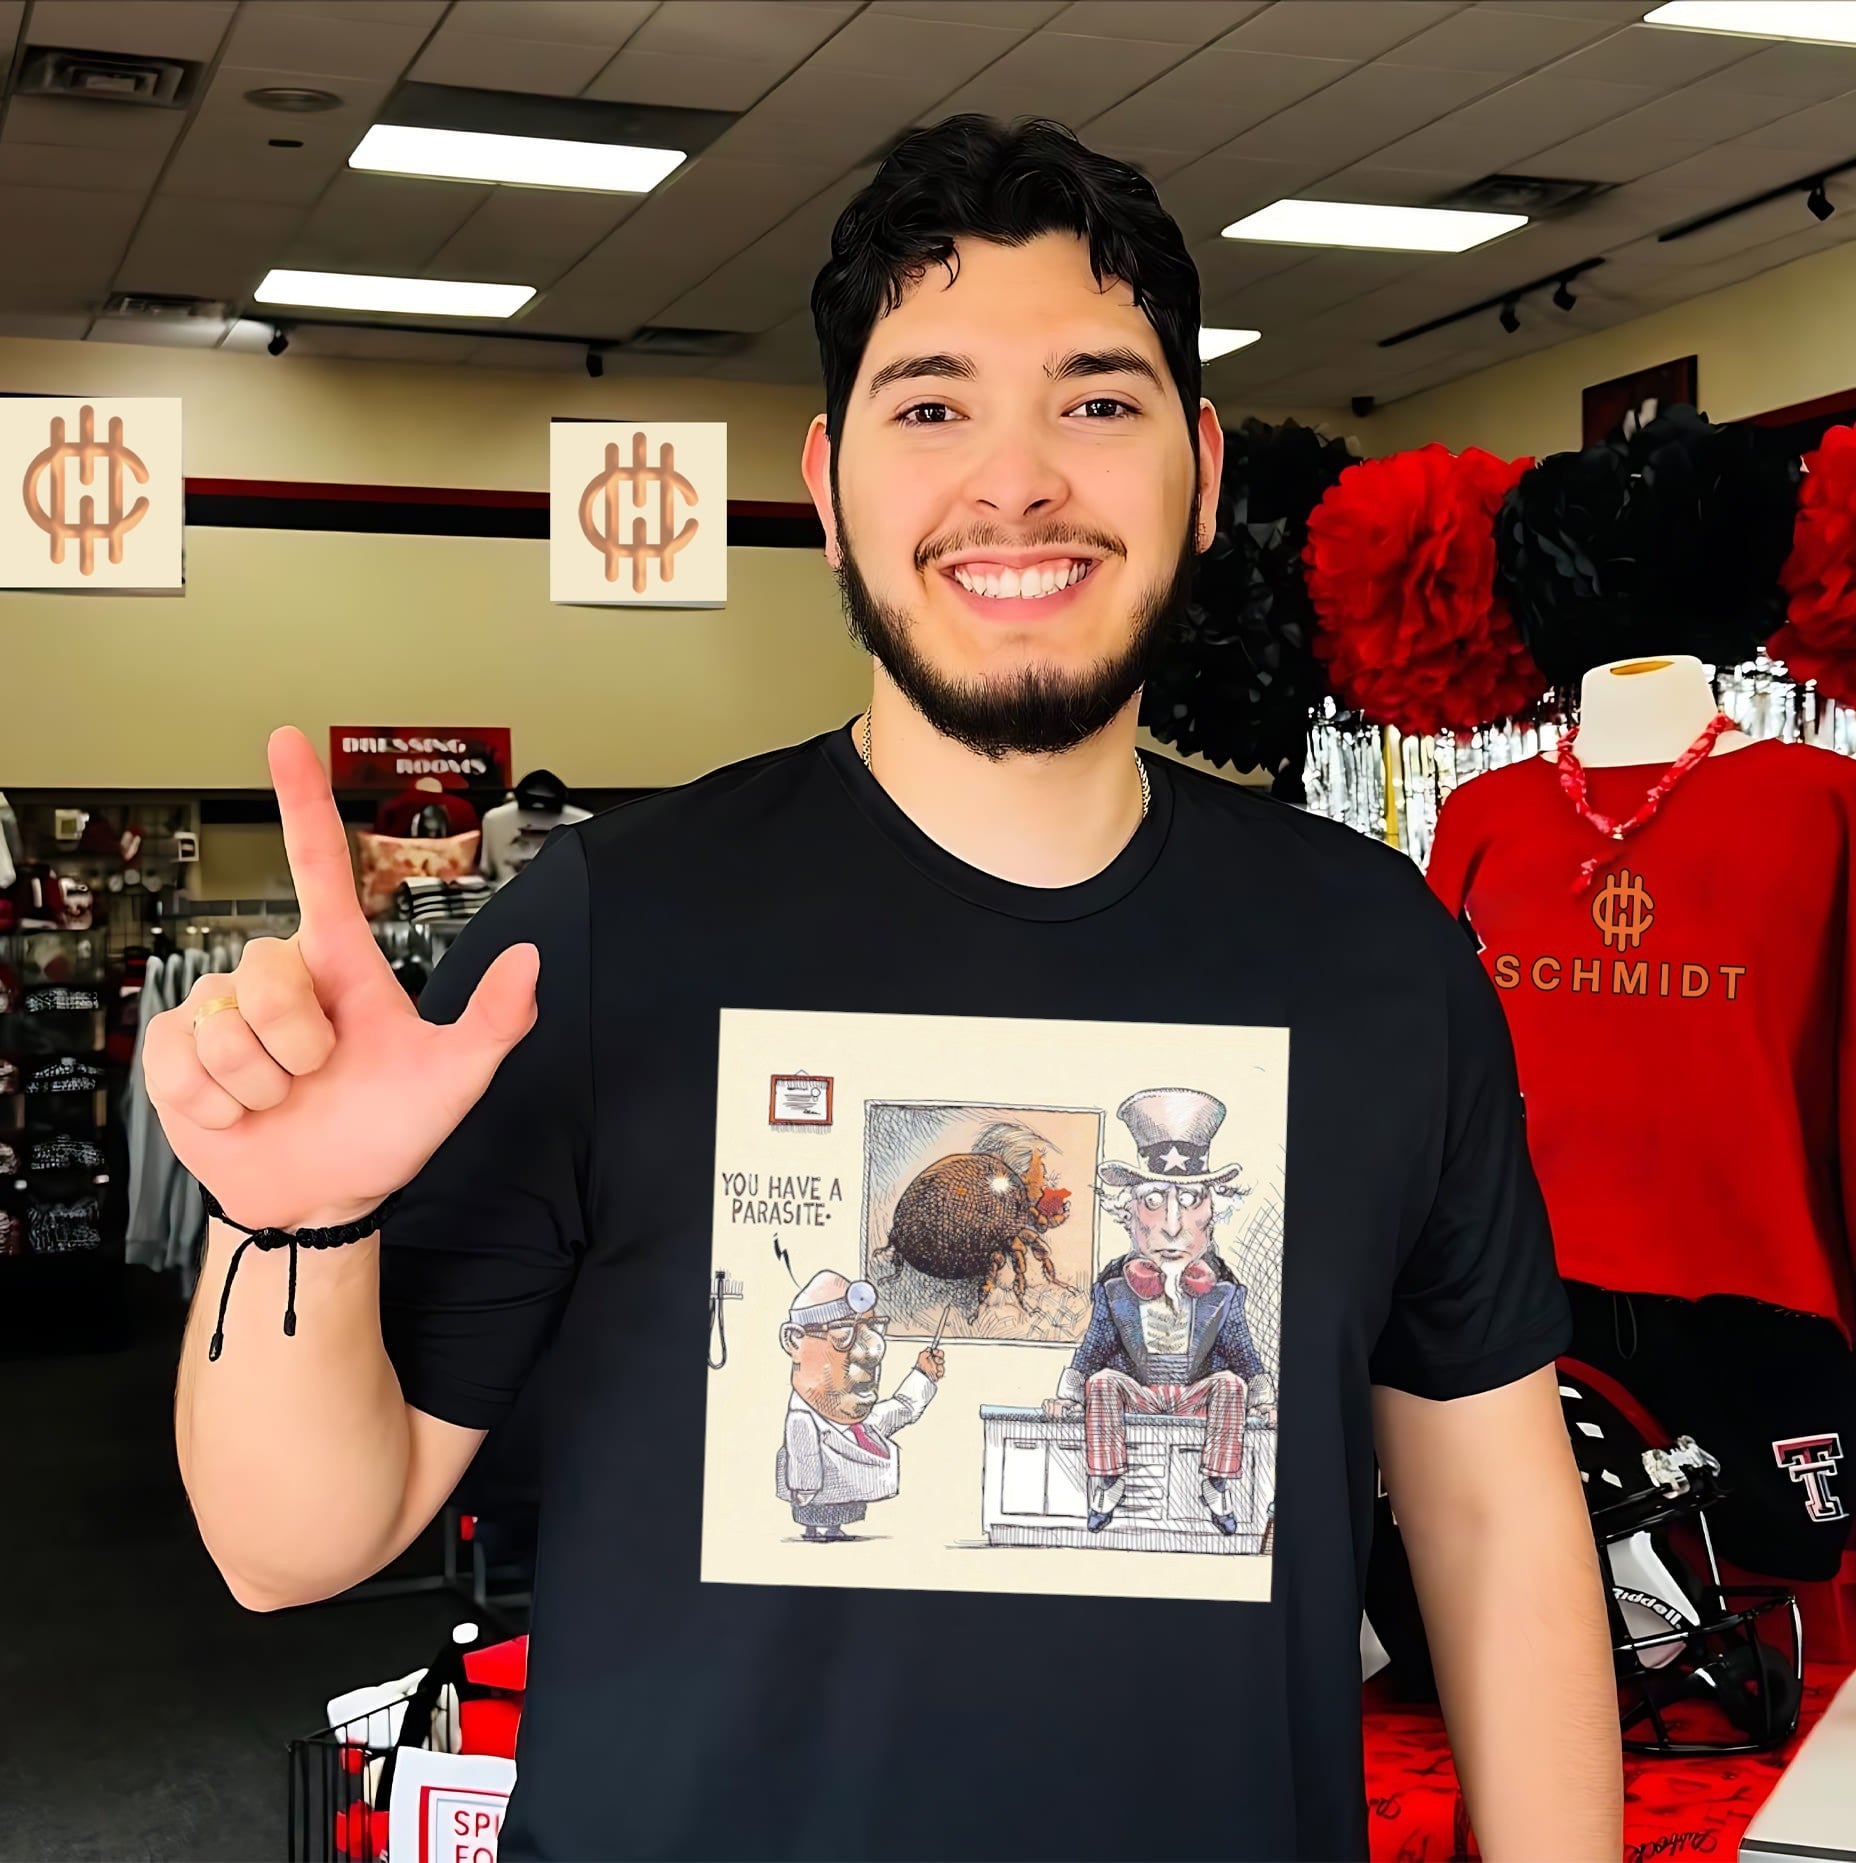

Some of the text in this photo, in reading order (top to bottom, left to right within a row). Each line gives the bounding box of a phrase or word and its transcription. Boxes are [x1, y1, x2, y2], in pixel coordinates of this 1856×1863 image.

[342, 737, 467, 754] DRESSING
[396, 758, 487, 775] ROOMS
[1494, 953, 1747, 1001] SCHMIDT
[722, 1172, 843, 1202] YOU HAVE A
[731, 1198, 832, 1227] PARASITE.
